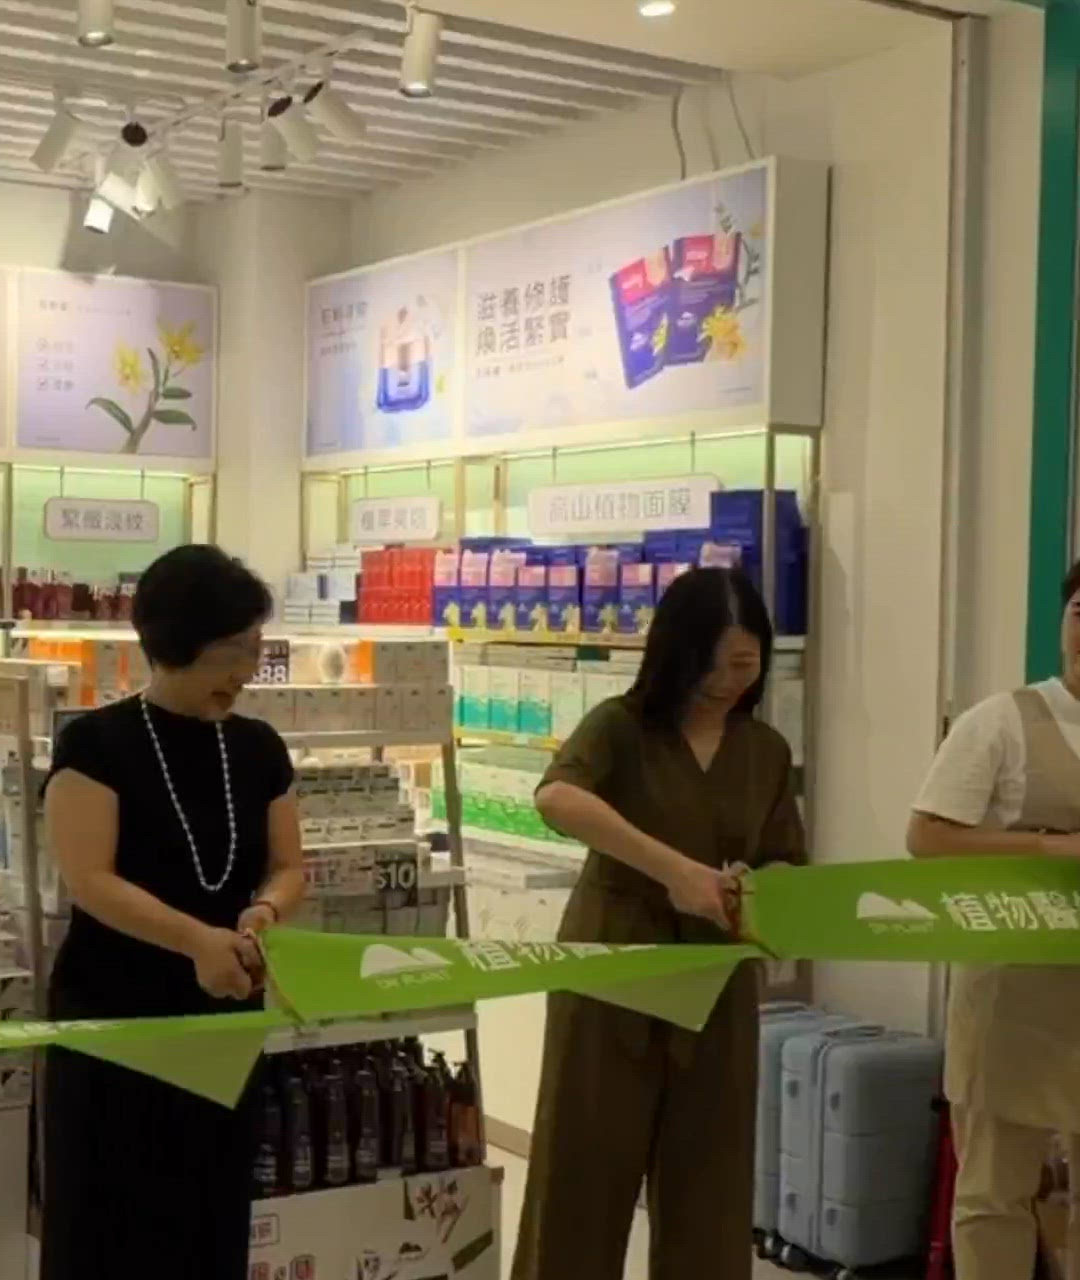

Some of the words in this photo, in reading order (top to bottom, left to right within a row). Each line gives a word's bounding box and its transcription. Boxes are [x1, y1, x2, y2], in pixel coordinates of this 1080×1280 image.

[549, 488, 691, 523] 高山植物面膜
[940, 890, 1080, 931] 植物醫
